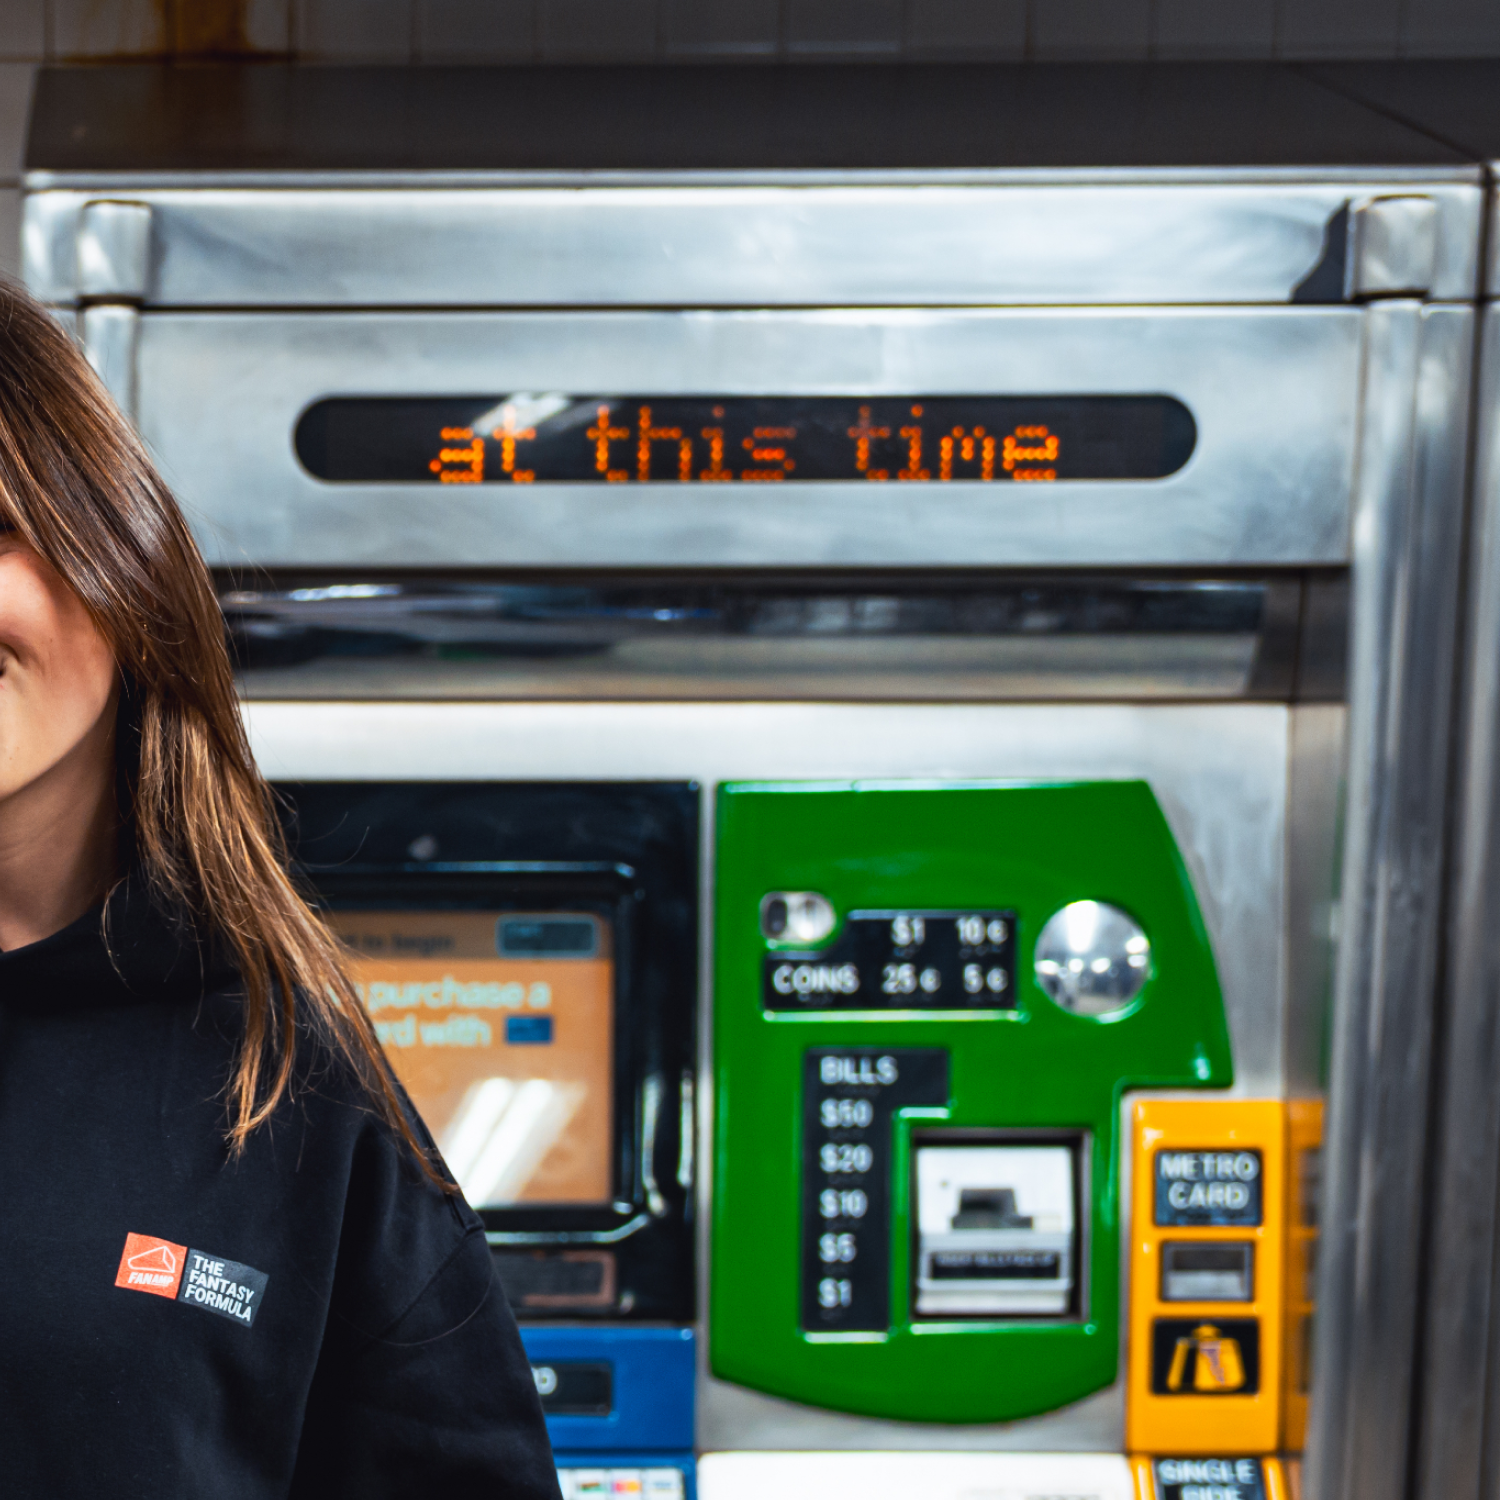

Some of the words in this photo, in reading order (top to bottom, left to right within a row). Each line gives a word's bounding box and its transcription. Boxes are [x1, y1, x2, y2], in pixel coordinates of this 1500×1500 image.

[429, 404, 537, 482] at
[587, 404, 796, 482] this
[847, 404, 1059, 482] time
[891, 914, 925, 946] $1
[367, 973, 525, 1014] purchase
[528, 980, 551, 1010] a
[773, 963, 860, 995] COINS
[419, 1013, 492, 1047] with
[820, 1055, 899, 1085] BILLS
[820, 1098, 874, 1129] $50
[820, 1143, 874, 1174] $20
[1160, 1152, 1259, 1181] METRO
[820, 1188, 869, 1219] $10
[1168, 1181, 1250, 1210] CARD
[819, 1232, 857, 1263] $5
[194, 1255, 225, 1277] THE
[189, 1270, 255, 1304] FANTASY
[818, 1277, 852, 1308] $1
[184, 1284, 252, 1322] FORMULA
[1159, 1459, 1257, 1485] SINGLE
